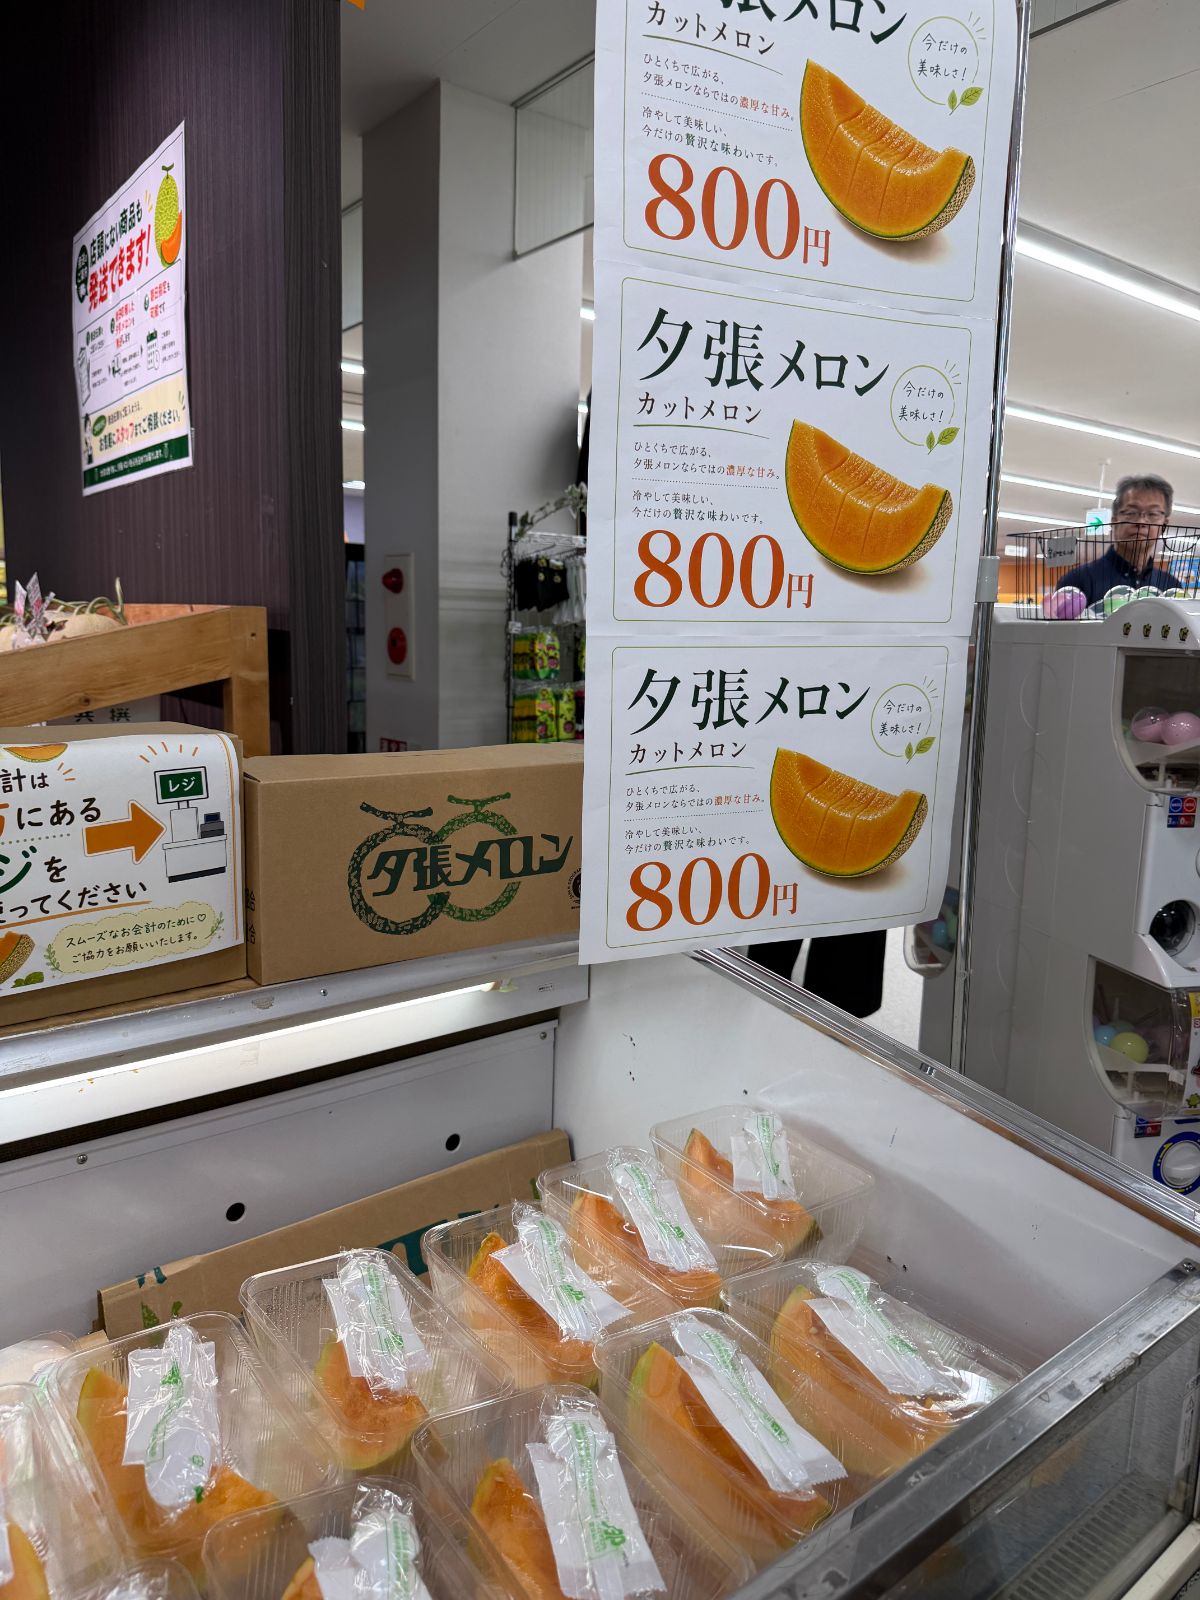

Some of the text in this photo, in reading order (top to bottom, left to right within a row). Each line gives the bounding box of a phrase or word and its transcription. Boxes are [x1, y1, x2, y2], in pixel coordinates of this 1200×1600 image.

[646, 1, 776, 56] カットメロン
[922, 33, 968, 55] 今だけの
[643, 53, 725, 86] ひとくちで広がる、
[643, 72, 795, 121] 夕張メロンならではの濃厚な甘み。
[641, 106, 728, 137] 冷やして美味しい、
[641, 124, 779, 168] 今だけの贅沢な味わいです。
[644, 153, 831, 268] 800円
[637, 306, 890, 397] 夕張メロン
[902, 382, 945, 400] 今だけの
[636, 391, 763, 424] カットメロン
[634, 441, 712, 459] ひとくちで広がる、
[633, 458, 781, 481] 夕張メロンならではの濃厚な甘み。
[632, 489, 714, 506] 冷やして美味しい、
[631, 506, 765, 525] 今だけの贅沢な味わいです。
[633, 529, 815, 609] 800円
[627, 668, 871, 735] 夕張メロン
[882, 699, 923, 715] 今だけの
[628, 740, 748, 766] カットメロン
[168, 776, 196, 793] レジ
[626, 782, 700, 797] ひとくちで広がる、
[625, 794, 765, 813] 夕張メロンならではの濃厚な甘み。
[624, 825, 703, 841] 冷やして美味しい、
[624, 835, 752, 855] 今だけの贅沢な味わいです。
[366, 833, 574, 898] 夕張メロン
[625, 852, 800, 933] 800円
[71, 933, 200, 965] ご協力をお願いいたします。
